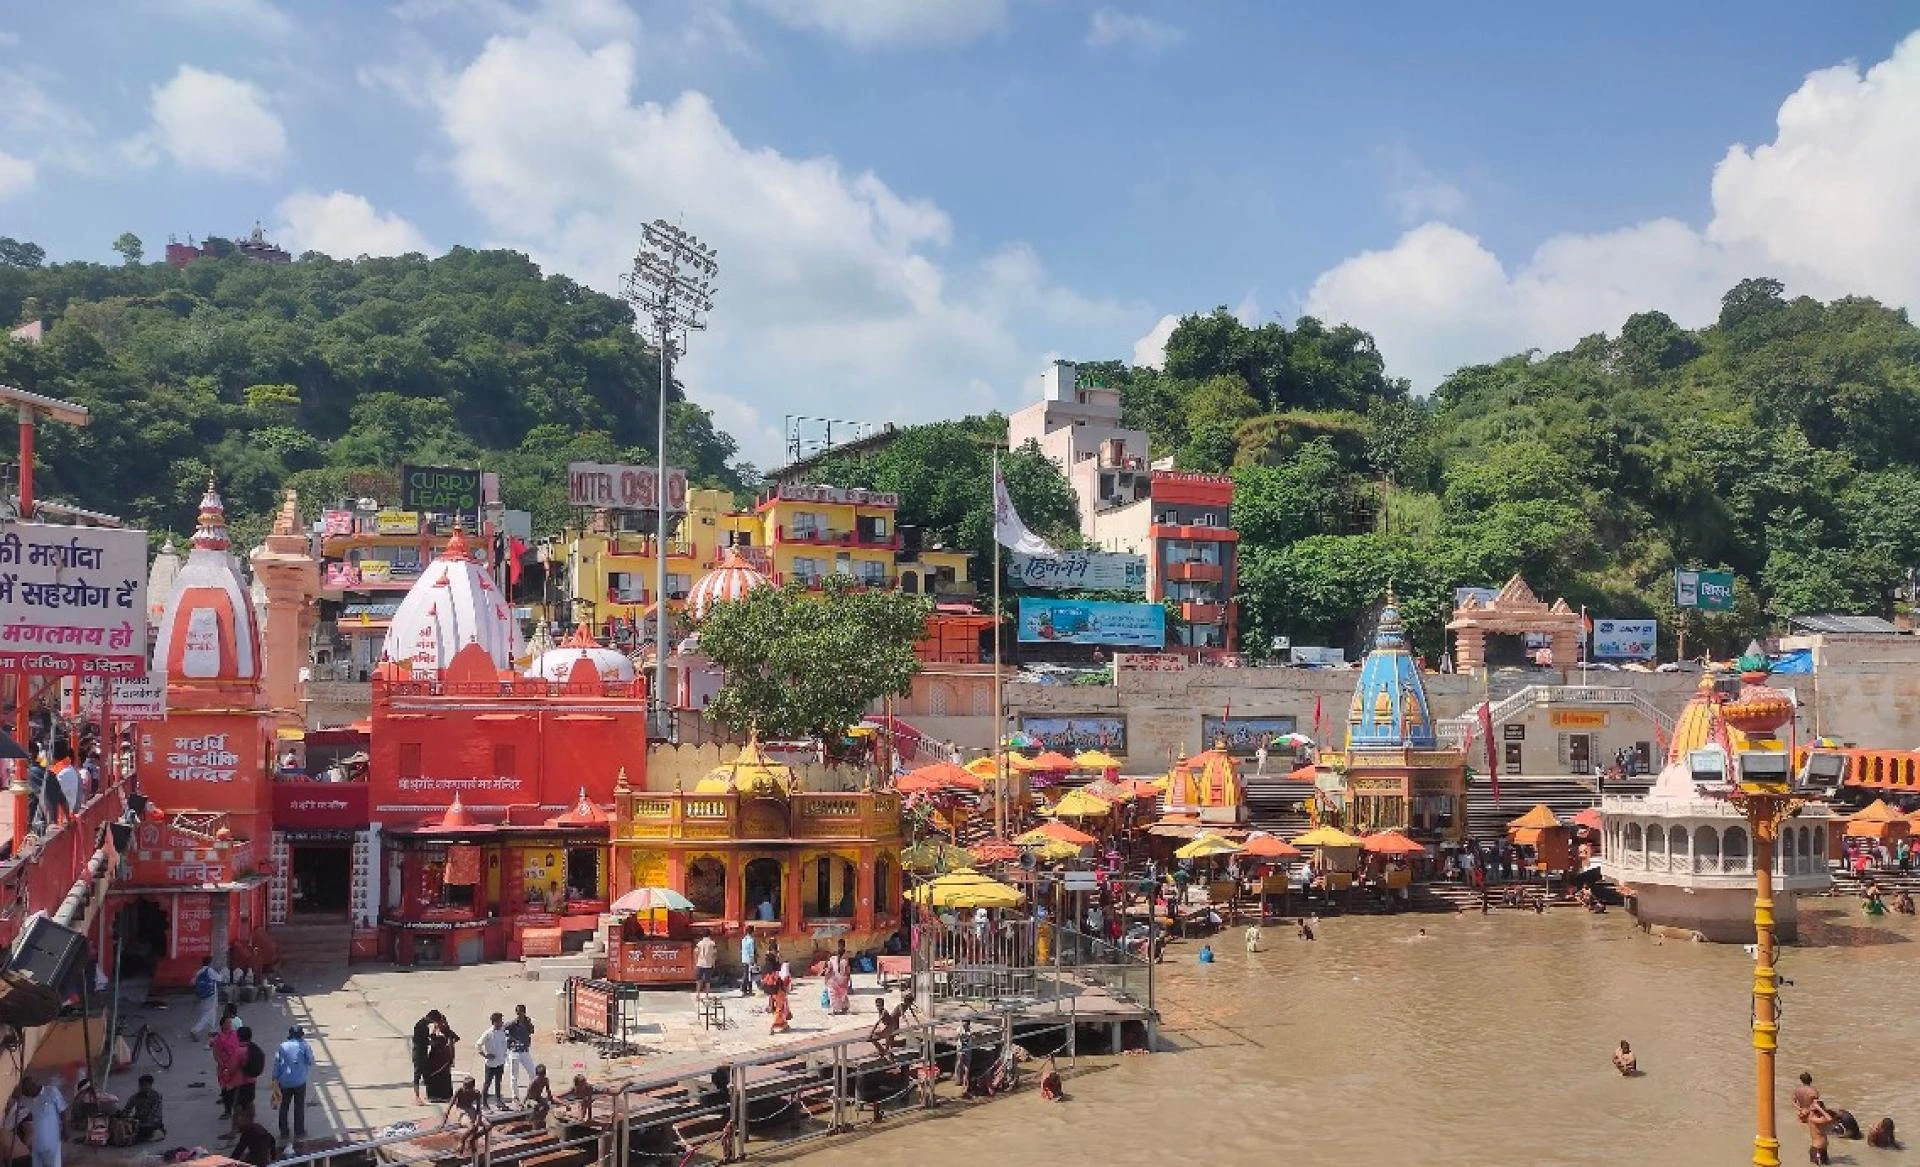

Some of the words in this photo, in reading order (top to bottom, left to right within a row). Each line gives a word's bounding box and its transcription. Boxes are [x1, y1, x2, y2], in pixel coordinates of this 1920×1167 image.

[410, 489, 457, 507] LEAF
[411, 473, 475, 490] CURRY
[571, 470, 613, 503] HOTEL
[21, 576, 111, 609] सहयोग
[116, 578, 138, 609] दें
[2, 616, 105, 645] मंगलमय
[108, 621, 134, 650] हो
